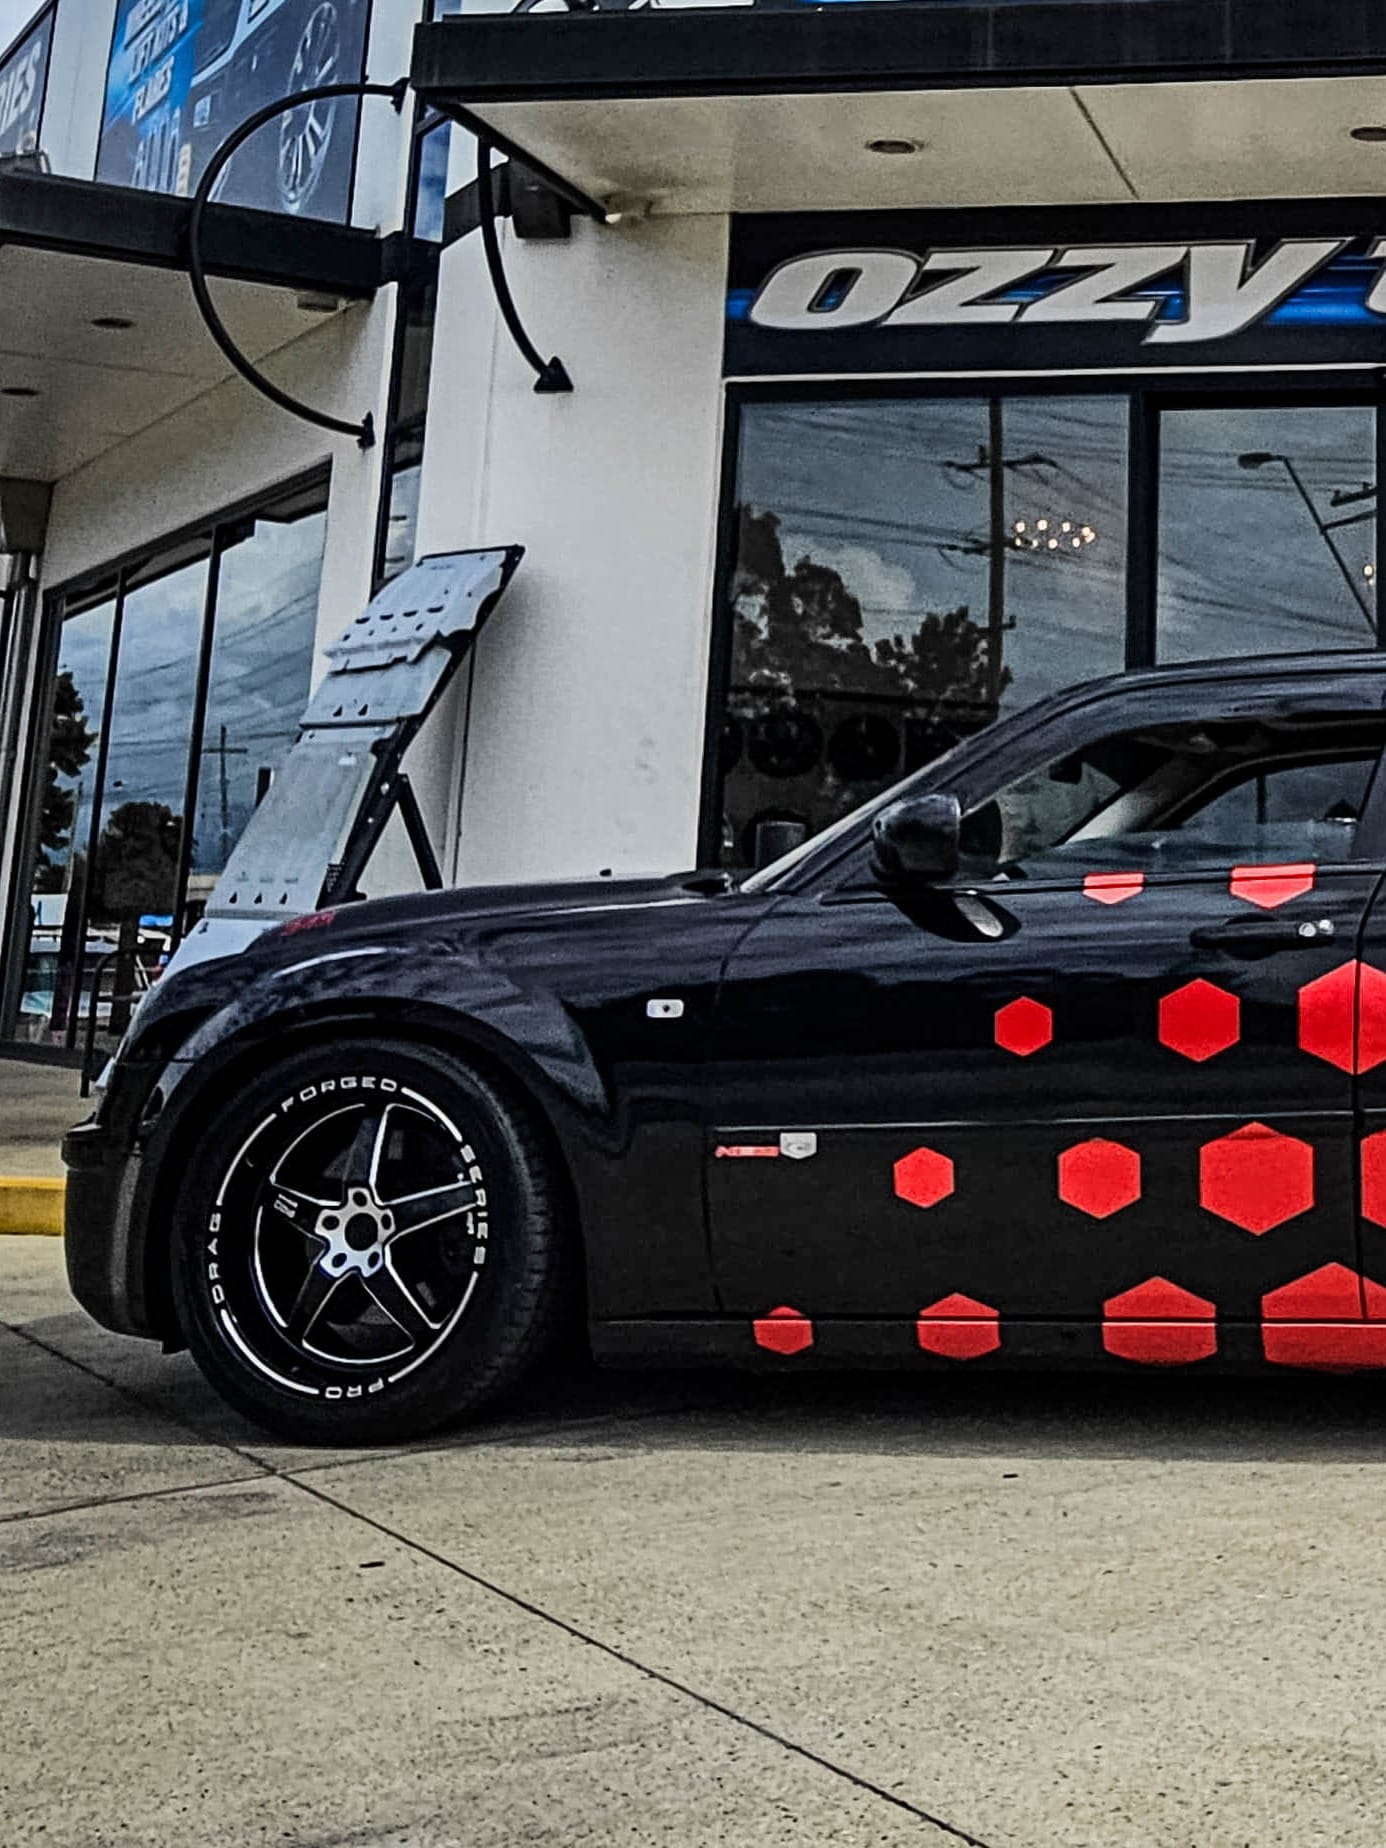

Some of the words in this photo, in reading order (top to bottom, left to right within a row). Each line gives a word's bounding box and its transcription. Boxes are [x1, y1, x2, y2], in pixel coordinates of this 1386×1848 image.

[747, 240, 1344, 345] ozzy
[281, 1075, 398, 1112] FORGED
[460, 1144, 489, 1265] SERIES
[207, 1212, 226, 1304] DRAG
[325, 1377, 386, 1399] PRO
